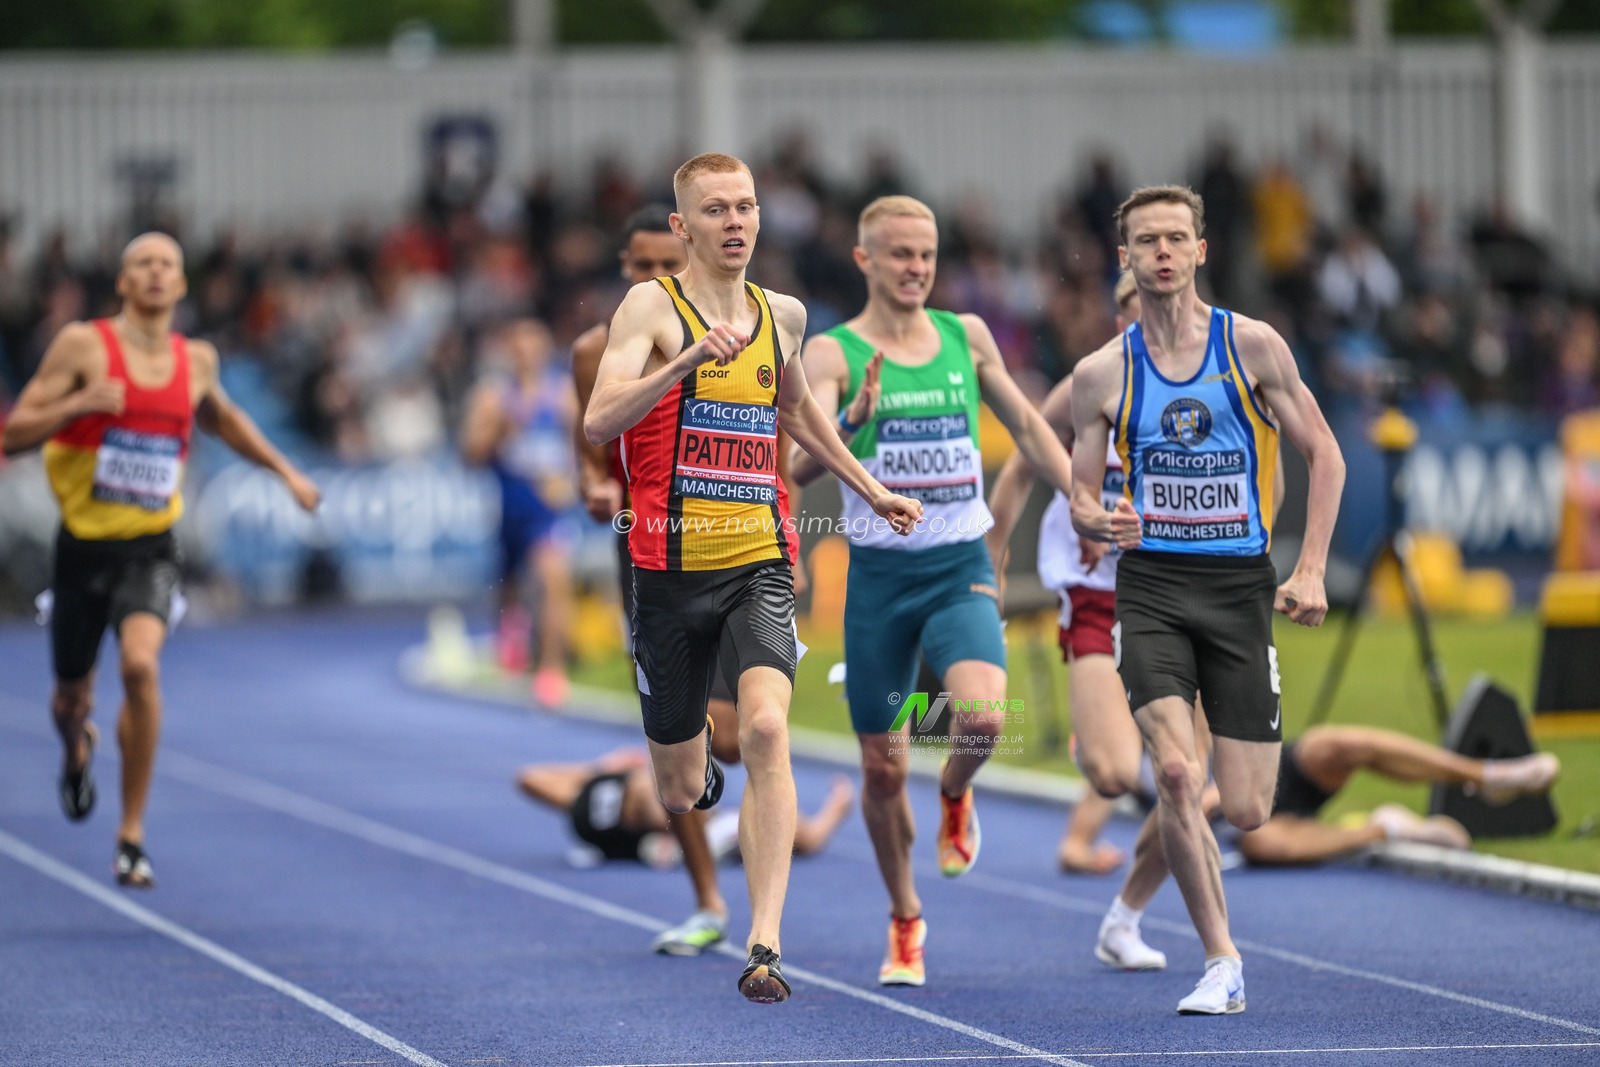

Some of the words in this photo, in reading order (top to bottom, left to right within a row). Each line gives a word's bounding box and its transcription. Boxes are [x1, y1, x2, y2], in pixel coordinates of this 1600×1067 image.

[700, 369, 730, 379] soar
[692, 402, 774, 431] Microplus
[692, 417, 710, 425] DATA
[712, 420, 751, 429] PROCESSING
[882, 415, 967, 439] Microplus
[684, 433, 774, 471] PATTISON
[883, 447, 973, 475] RANDOLPH
[1149, 451, 1241, 476] Microplus
[693, 471, 730, 480] ATHLETICS
[681, 479, 774, 501] MANCHESTER
[1152, 482, 1239, 511] BURGIN
[1149, 522, 1243, 539] MANCHESTER
